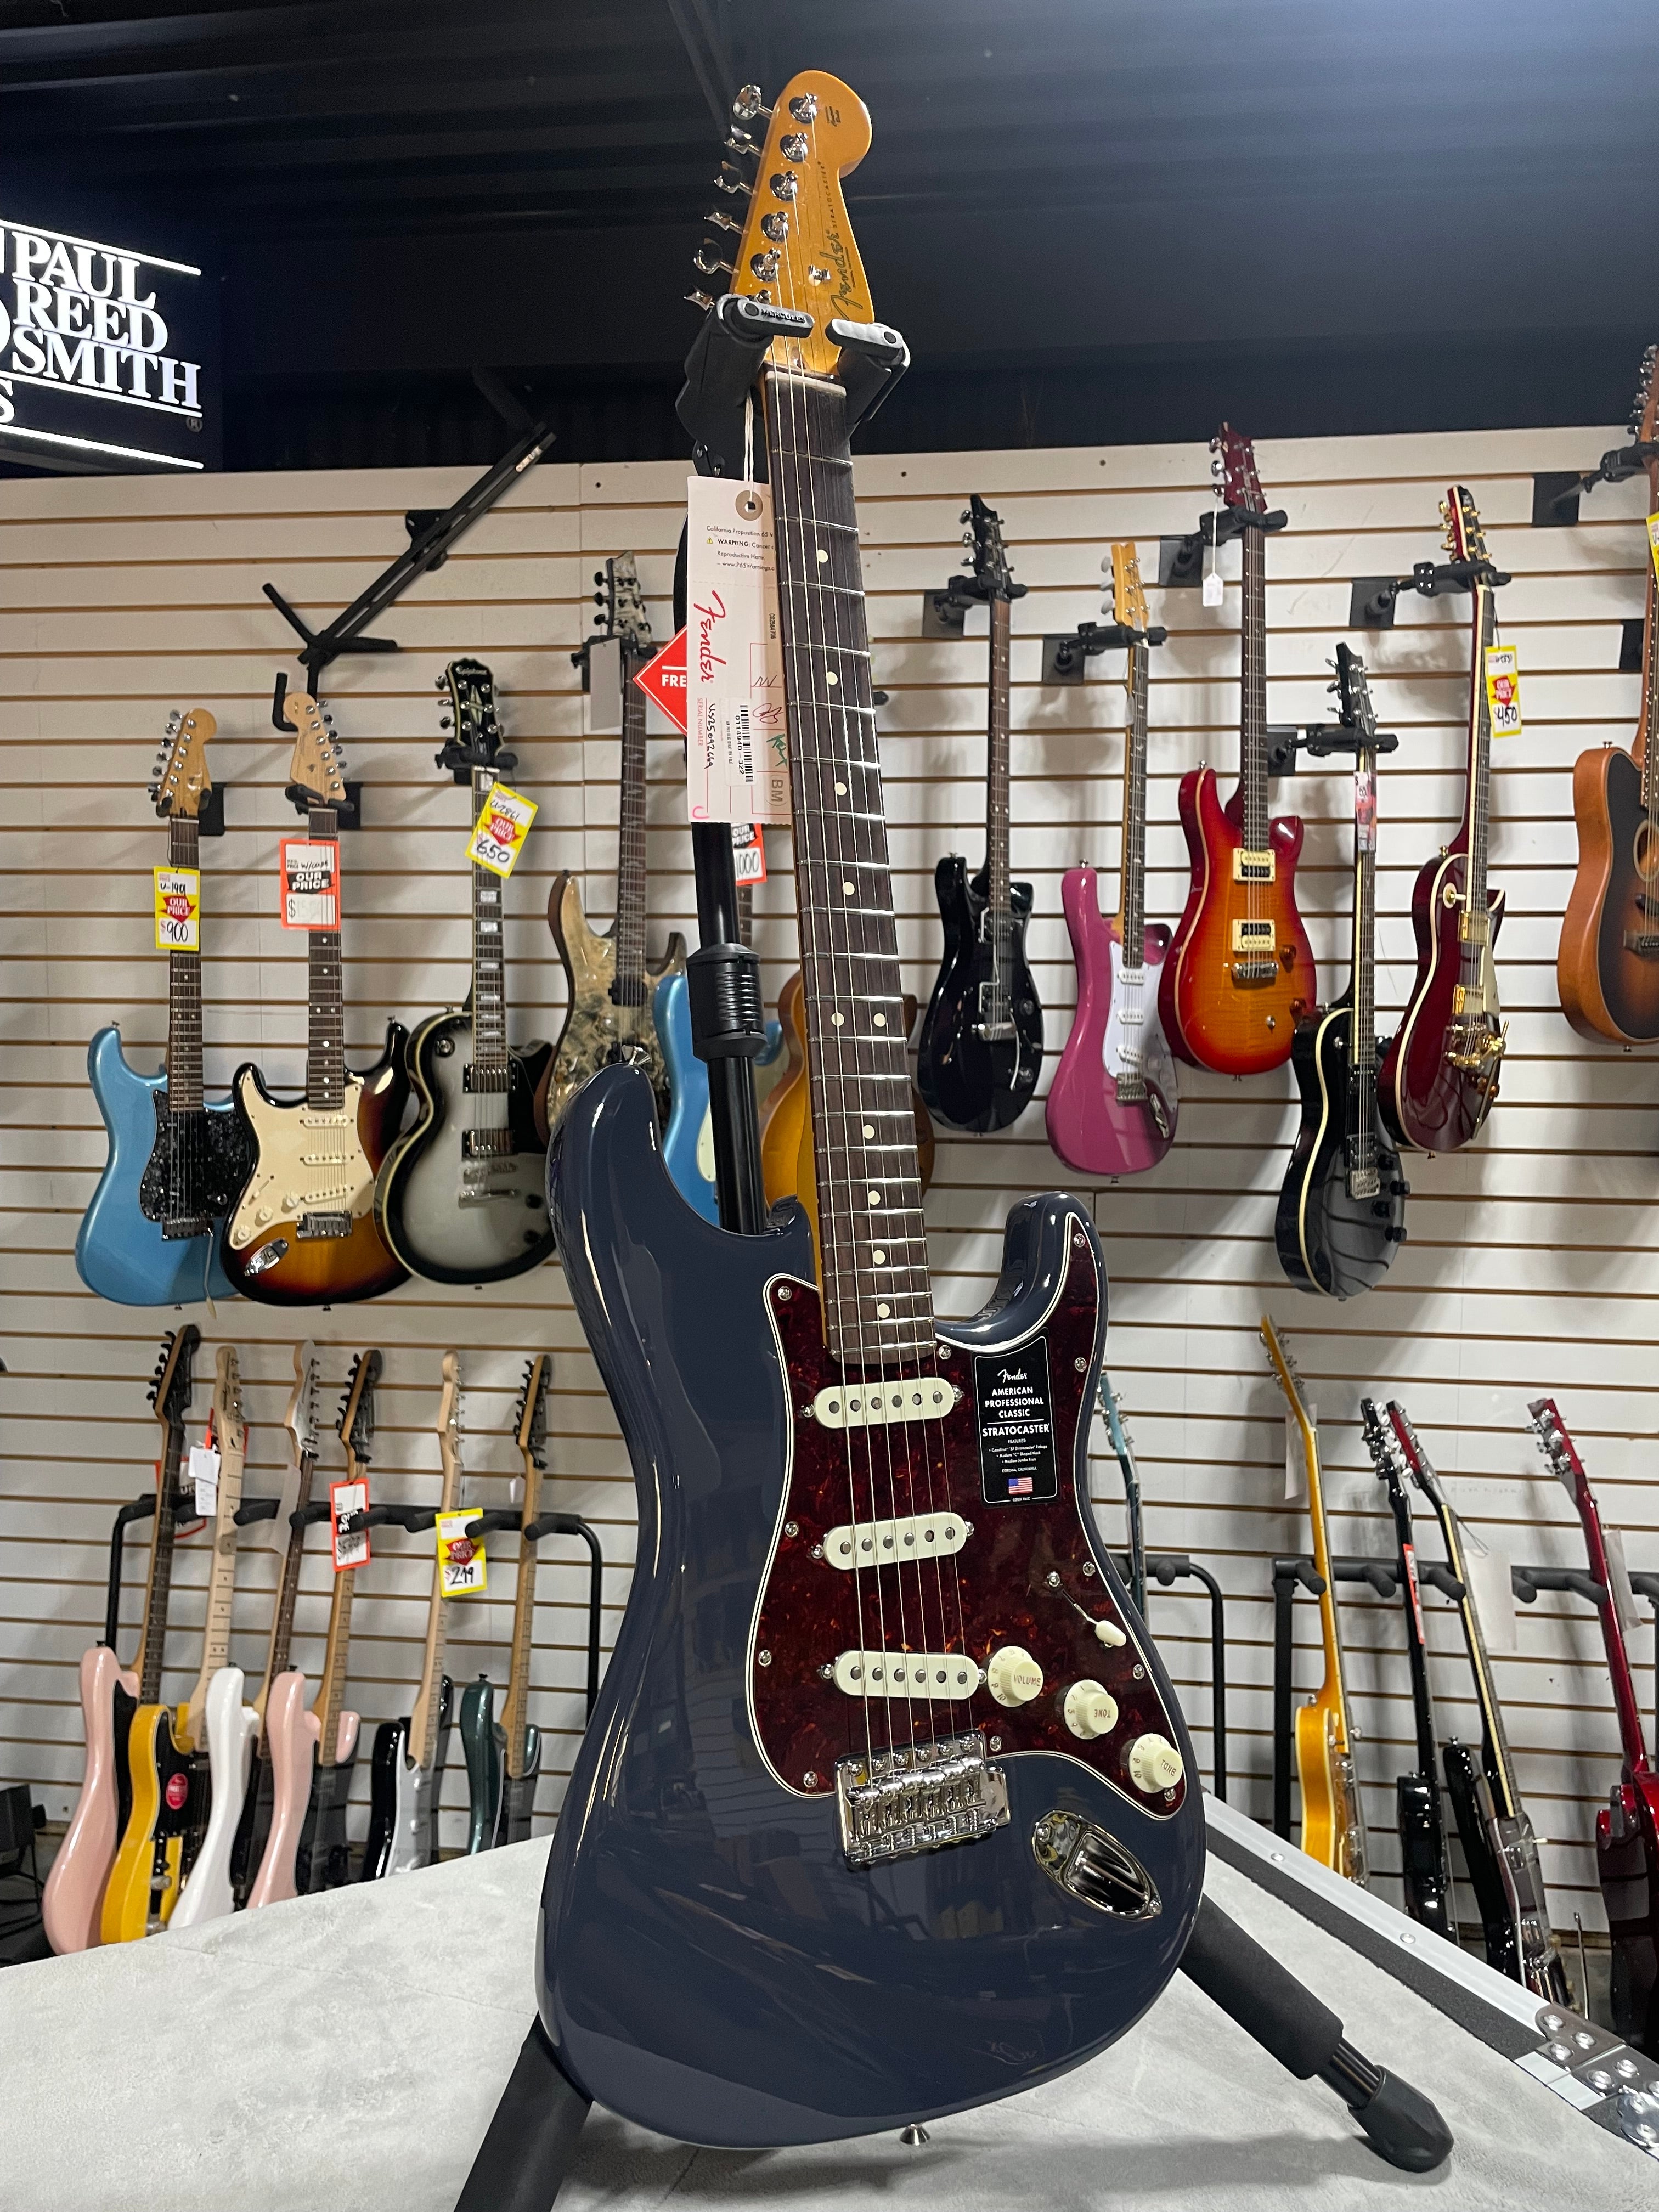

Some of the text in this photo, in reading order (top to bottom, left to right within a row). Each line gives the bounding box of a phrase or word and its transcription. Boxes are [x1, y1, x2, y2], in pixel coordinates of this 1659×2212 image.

[12, 232, 156, 309] PAUL
[820, 233, 863, 320] Fender
[12, 278, 168, 354] REED
[761, 309, 805, 323] HERCULES
[12, 325, 201, 409] SMITH
[718, 539, 751, 547] WARNING:
[718, 550, 749, 558] Reproductive
[693, 590, 726, 683] Fender
[662, 675, 687, 687] FRE
[732, 824, 750, 837] OUR
[296, 872, 322, 882] OUR
[292, 879, 329, 891] PRICE
[170, 897, 187, 906] OUR
[167, 906, 190, 916] PRICE
[997, 1368, 1027, 1383] Fender
[992, 1386, 1033, 1396] AMERICAN
[985, 1397, 1044, 1408] PROFESSIONAL
[998, 1409, 1030, 1418] CLASSIC
[982, 1424, 1049, 1437] STRATOCASTER
[1014, 1675, 1041, 1686] VOLUME
[1094, 1709, 1110, 1718] TONE
[1161, 1759, 1177, 1776] TONE
